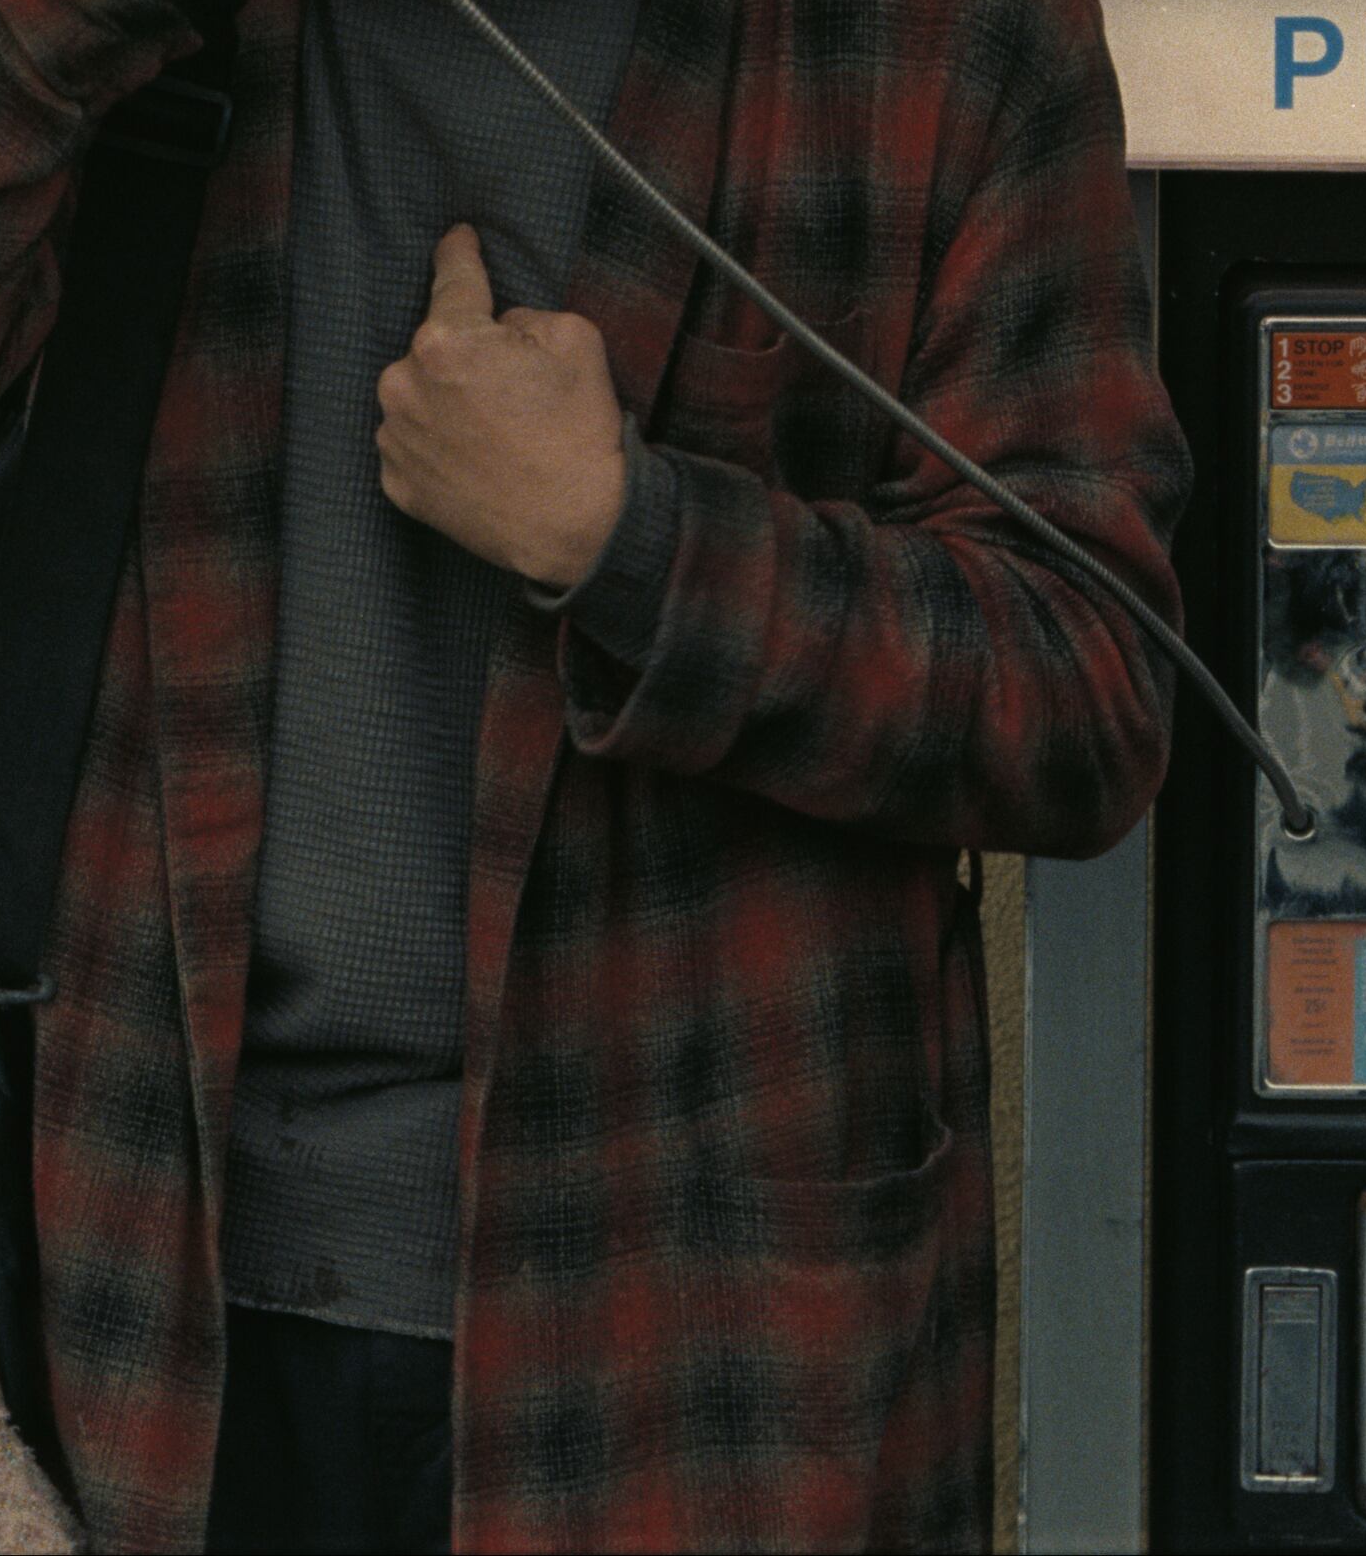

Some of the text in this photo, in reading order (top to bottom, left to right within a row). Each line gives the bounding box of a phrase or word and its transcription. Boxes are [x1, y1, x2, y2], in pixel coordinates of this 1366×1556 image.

[1277, 338, 1345, 358] 1 STOP
[1276, 360, 1292, 380] 2
[1276, 383, 1293, 404] 3
